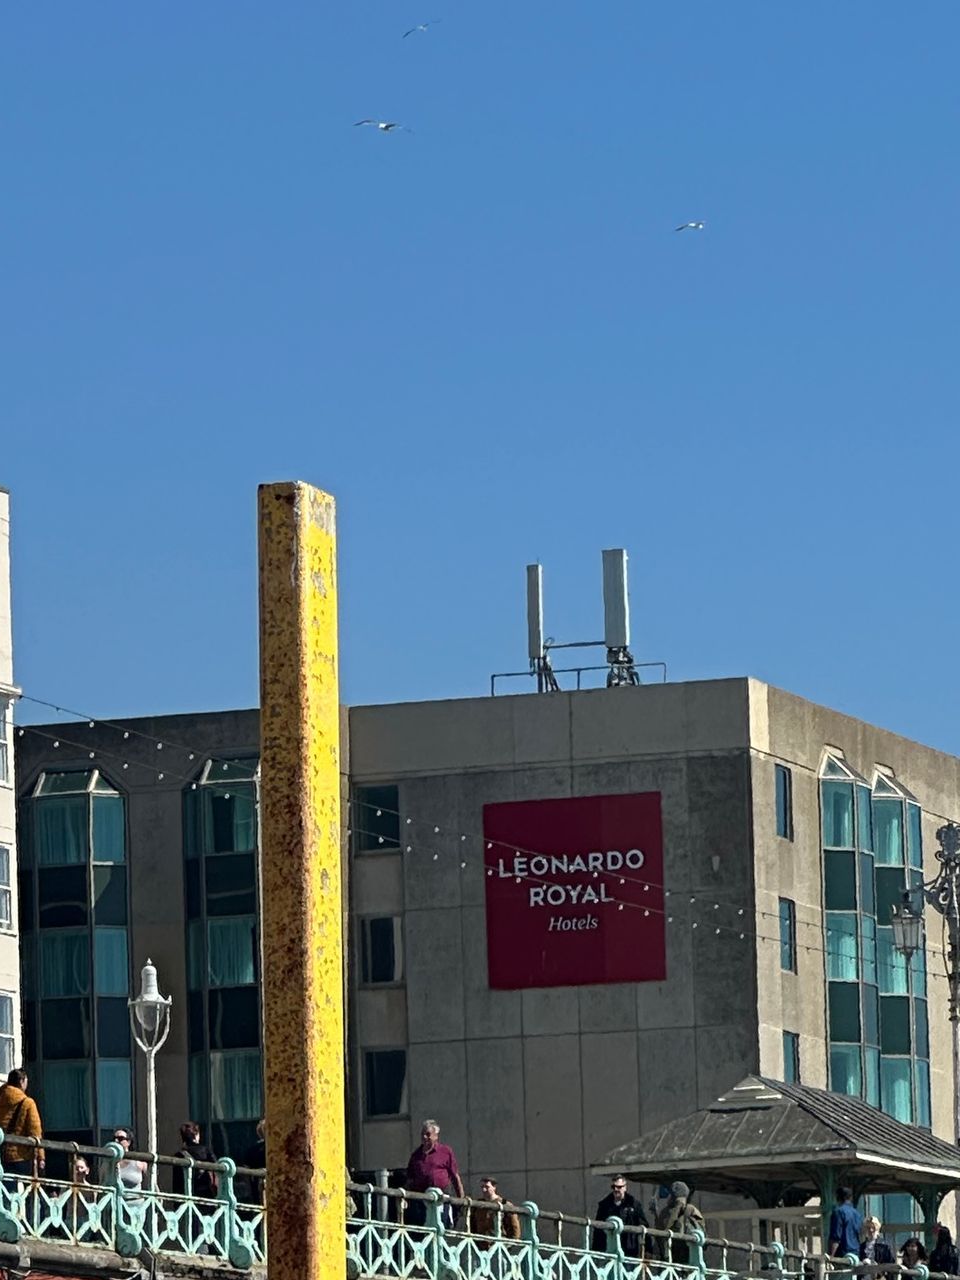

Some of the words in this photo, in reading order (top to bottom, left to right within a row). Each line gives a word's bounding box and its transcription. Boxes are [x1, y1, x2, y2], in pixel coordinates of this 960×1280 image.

[498, 849, 644, 878] LEONARDO
[529, 883, 615, 907] ROYAL
[548, 914, 598, 931] Hotels
